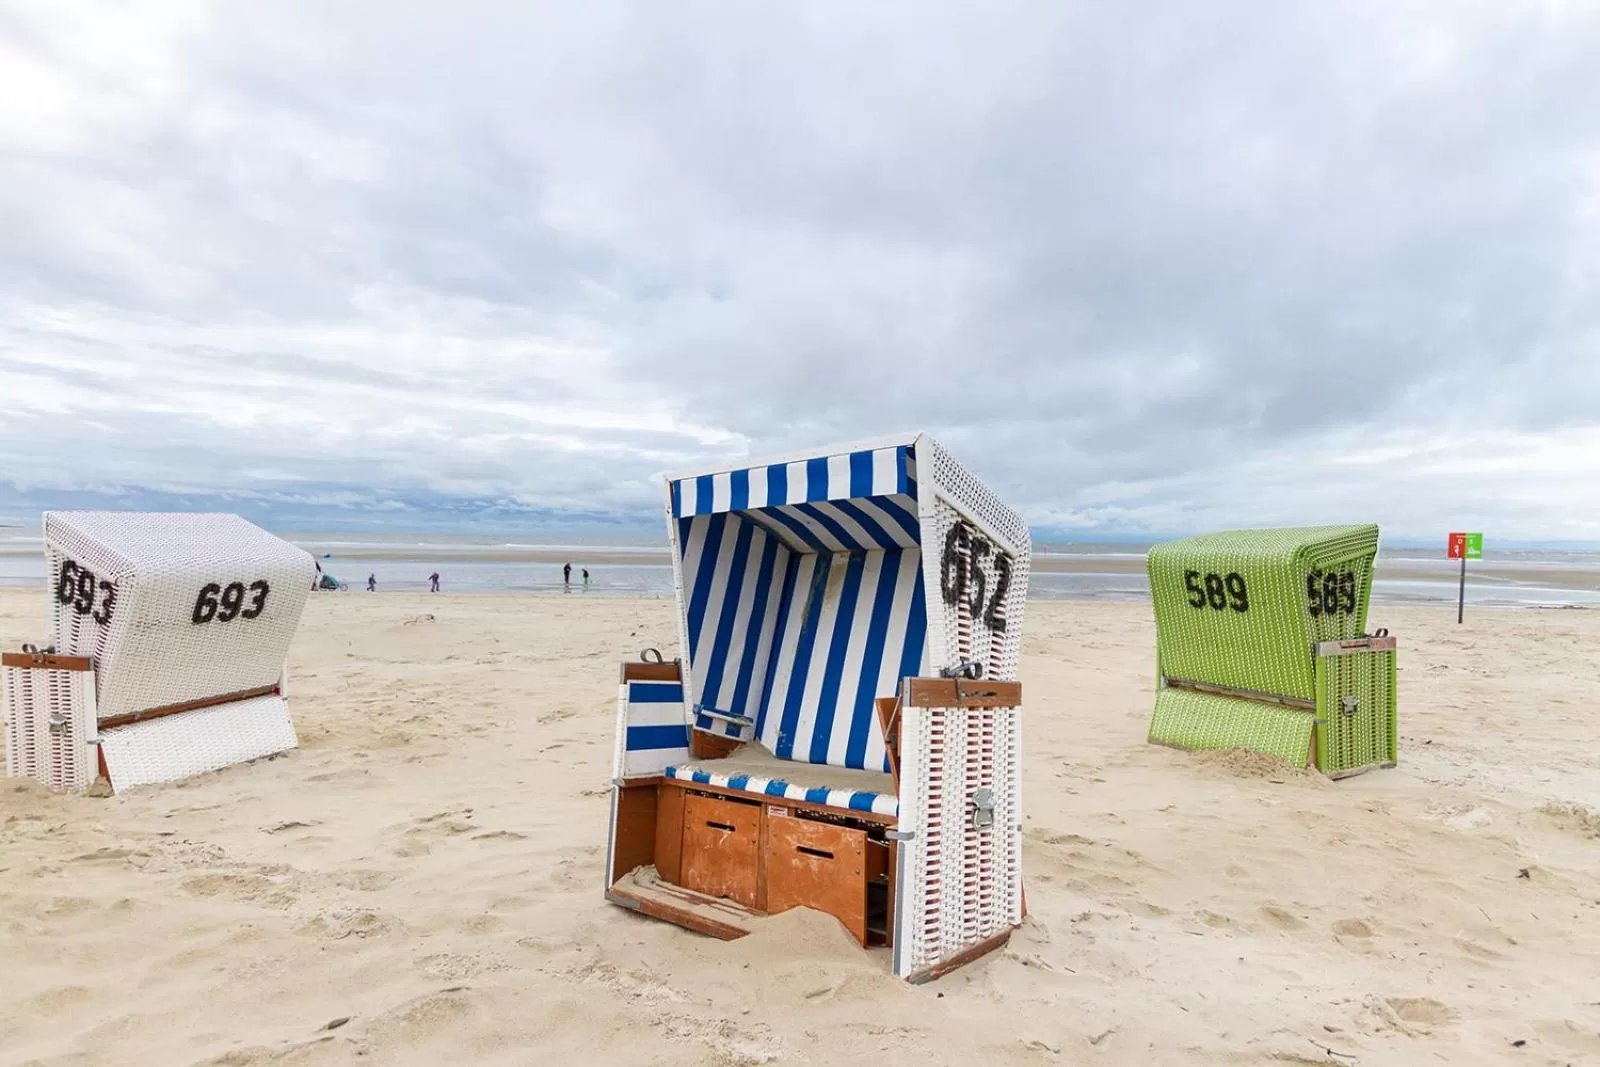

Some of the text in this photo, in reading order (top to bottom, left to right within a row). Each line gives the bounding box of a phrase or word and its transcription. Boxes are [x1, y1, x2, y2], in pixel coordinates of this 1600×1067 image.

[59, 560, 118, 625] 693
[191, 579, 270, 624] 693
[1184, 569, 1249, 613] 589
[1307, 569, 1355, 618] 589
